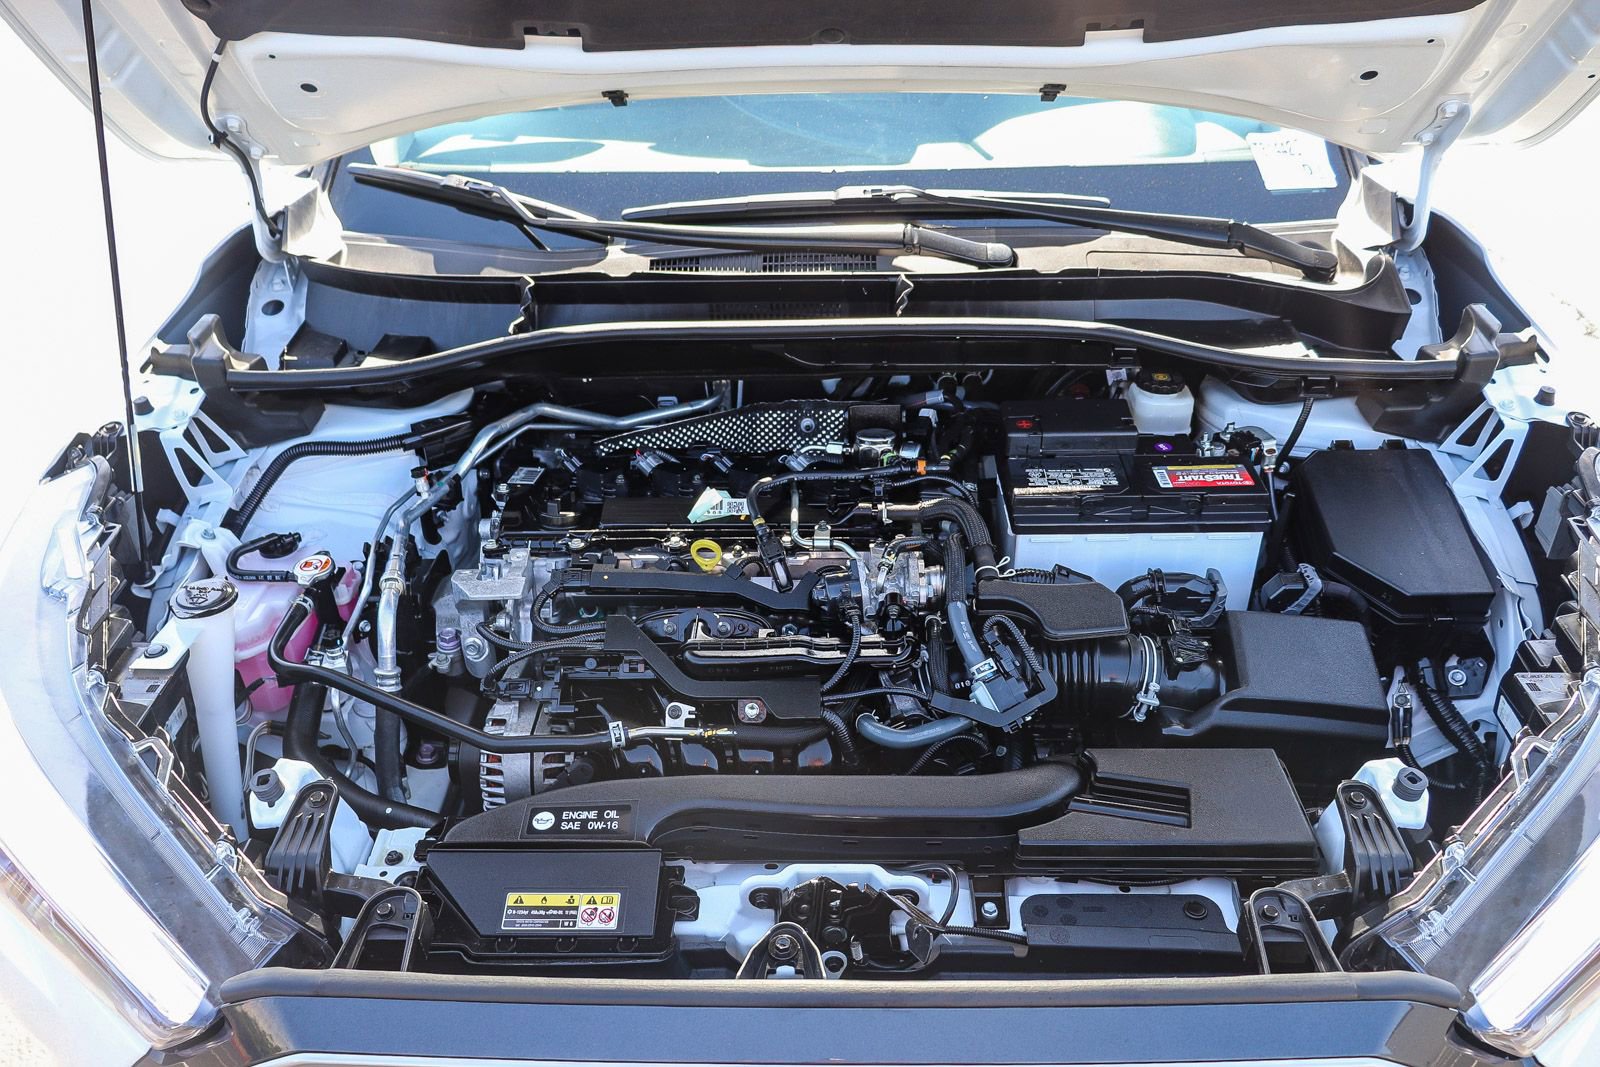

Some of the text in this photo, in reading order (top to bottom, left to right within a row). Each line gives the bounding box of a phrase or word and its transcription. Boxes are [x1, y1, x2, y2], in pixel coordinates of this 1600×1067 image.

[562, 810, 620, 820] ENGINE OIL
[560, 821, 619, 830] SAE 0W-16
